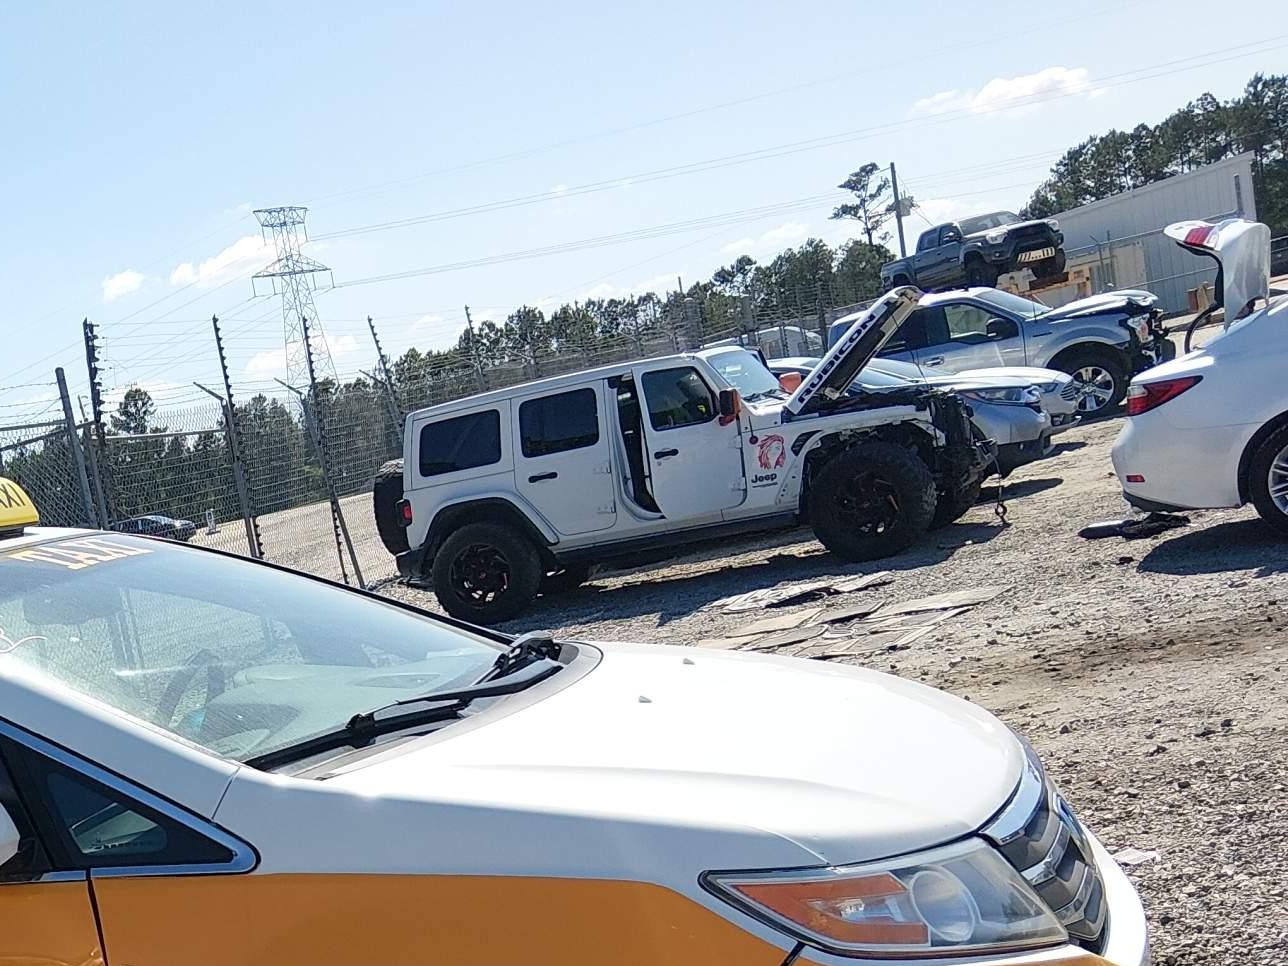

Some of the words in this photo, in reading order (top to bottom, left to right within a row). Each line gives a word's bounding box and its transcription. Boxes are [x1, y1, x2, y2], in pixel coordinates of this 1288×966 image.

[798, 313, 877, 404] RUBICON
[751, 473, 777, 483] Jeep
[8, 538, 155, 570] TAXI
